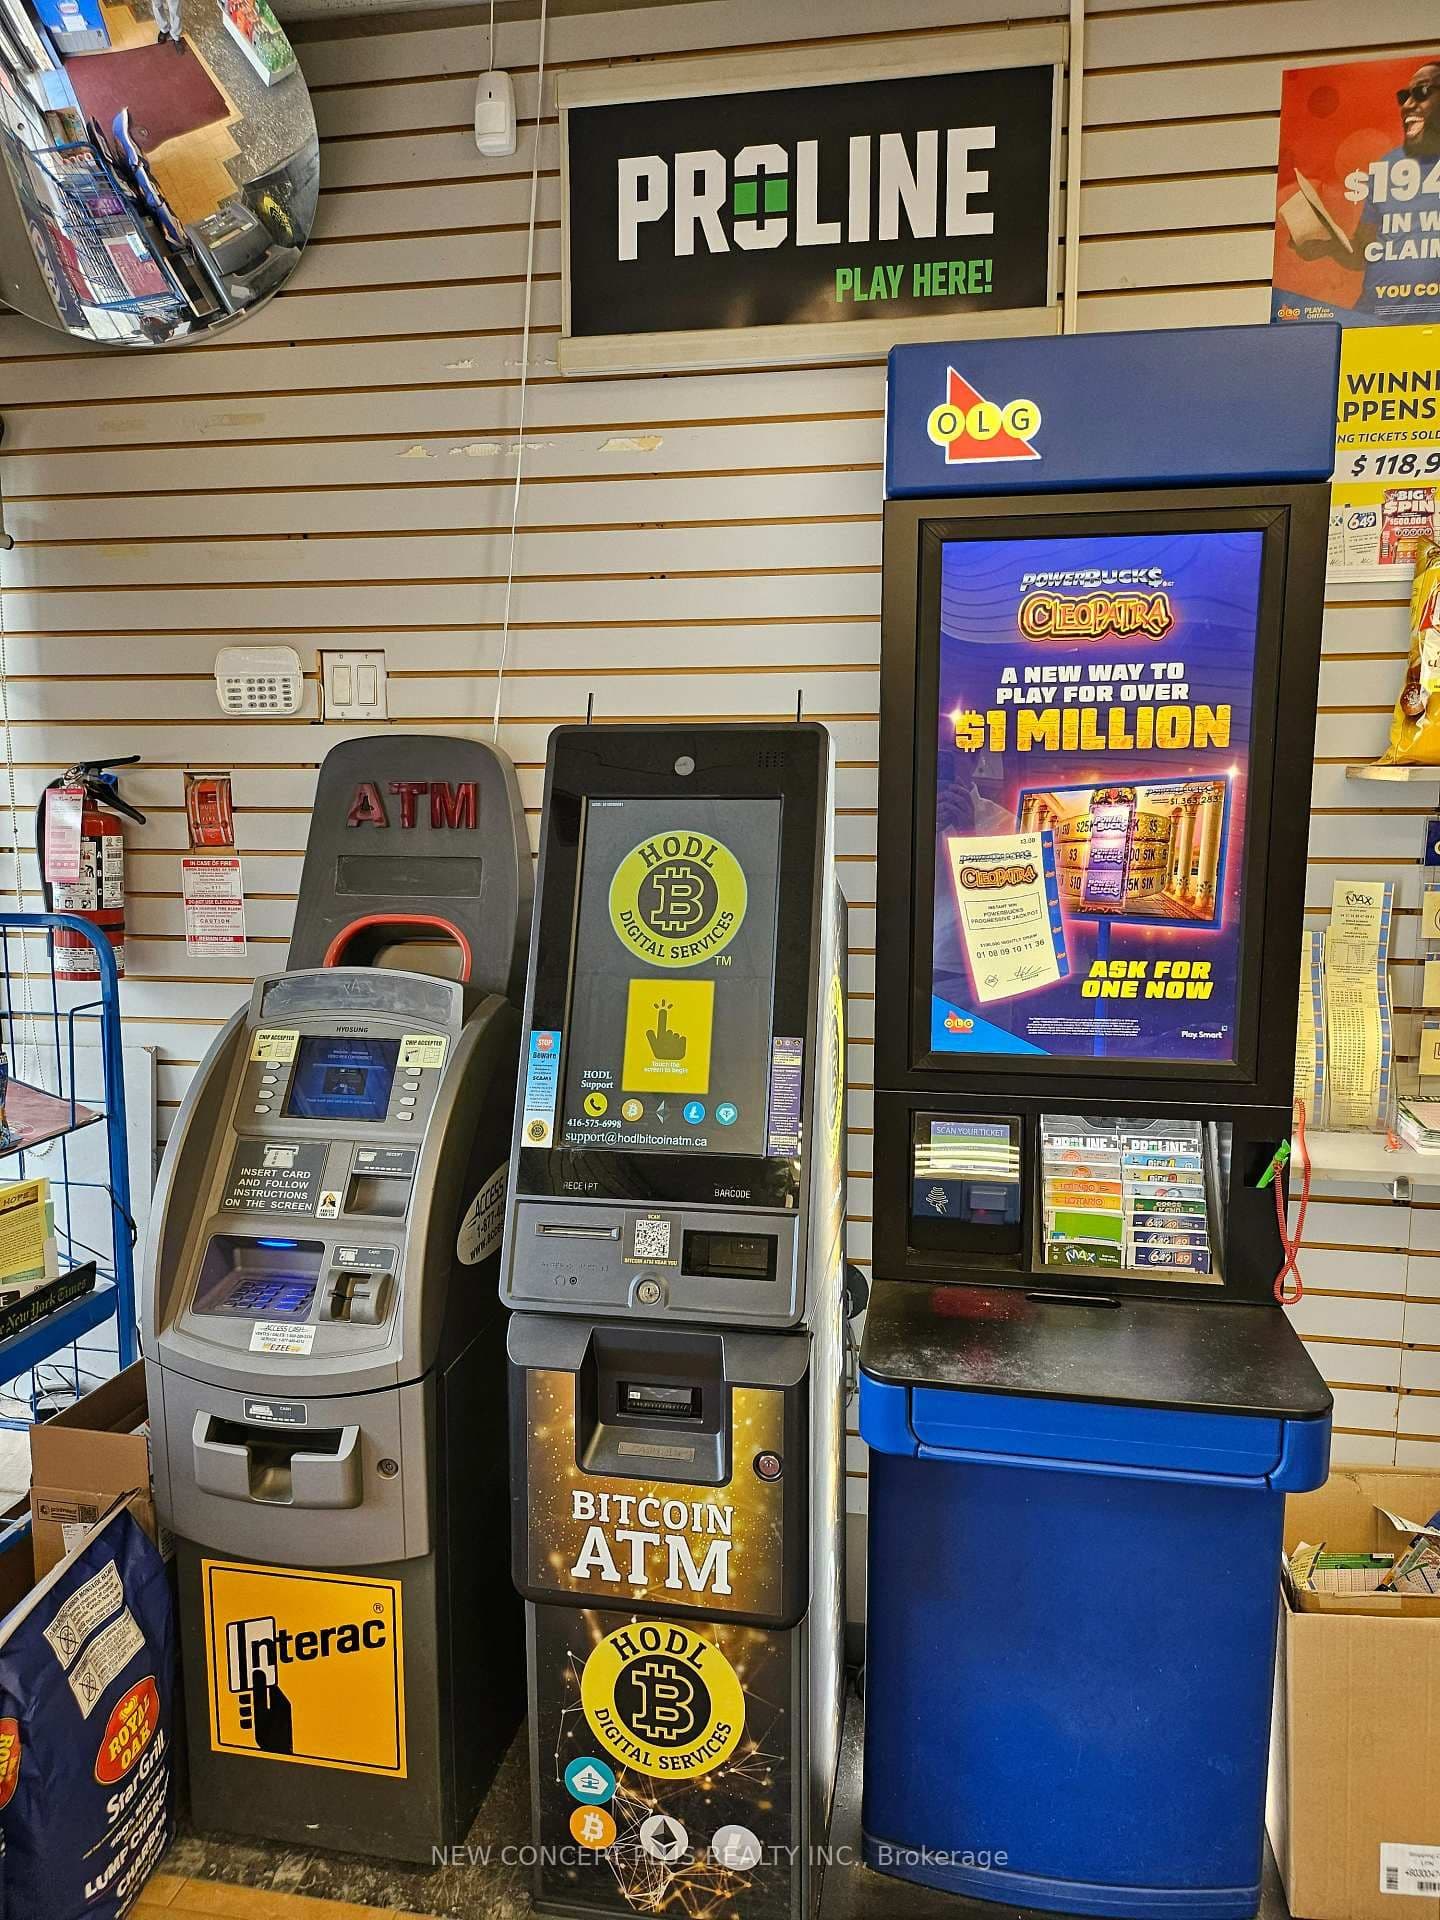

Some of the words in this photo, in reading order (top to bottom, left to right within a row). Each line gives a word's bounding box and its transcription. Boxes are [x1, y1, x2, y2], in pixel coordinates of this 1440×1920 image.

[617, 125, 996, 261] PROLINE
[1381, 211, 1412, 234] IN
[836, 264, 904, 303] PLAY
[912, 258, 994, 297] HERE!
[1375, 285, 1411, 299] YOU
[1414, 283, 1440, 297] CO
[1336, 397, 1437, 424] PPENS
[937, 407, 1030, 436] OLG
[1358, 431, 1408, 443] TICKETS
[1396, 489, 1424, 501] BIG
[1001, 667, 1018, 684] A
[1024, 665, 1082, 684] NEW
[1088, 663, 1146, 683] WAY
[1150, 662, 1185, 680] TO
[996, 687, 1057, 705] PLAY
[1063, 685, 1113, 703] FOR
[1120, 683, 1190, 702] OVER
[955, 709, 1007, 753] $1
[1016, 704, 1233, 752] MILLION
[347, 781, 479, 829] ATM
[638, 836, 719, 869] HODL
[1346, 893, 1373, 905] MAX
[619, 910, 665, 958] DIGITAL
[670, 911, 734, 959] SERVICES
[715, 955, 732, 966] TM
[1088, 961, 1148, 979] ASK
[1153, 961, 1211, 979] FOR
[1081, 980, 1139, 999] ONE
[1144, 980, 1214, 1000] NOW
[538, 1039, 553, 1047] STOP
[580, 1079, 614, 1090] Support
[583, 1070, 612, 1080] HODL
[567, 1118, 622, 1129] 416-575-6998
[936, 1126, 957, 1134] SCAN
[957, 1127, 979, 1136] YOUR
[979, 1128, 1004, 1137] TICKET
[565, 1131, 708, 1147] support@hodlbitcoinatm.ca
[238, 1178, 261, 1187] AND
[265, 1179, 309, 1189] FOLLOW
[240, 1168, 277, 1177] INSERT
[282, 1170, 311, 1179] CARD
[233, 1188, 308, 1200] INSTRUCTIONS
[563, 1181, 599, 1191] RECEIPT
[714, 1188, 751, 1199] BARCODE
[225, 1198, 240, 1207] ON
[245, 1199, 265, 1208] THE
[270, 1200, 312, 1211] SCREEN
[1065, 1248, 1097, 1263] MAX
[30, 1294, 57, 1321] York
[57, 1278, 87, 1300] Times
[264, 1324, 288, 1332] ACCESS
[269, 1344, 290, 1352] EZEE
[571, 1490, 734, 1536] BITCOIN
[570, 1525, 733, 1595] ATM
[236, 1617, 387, 1690] Interac
[609, 1626, 709, 1669] HODL
[108, 1694, 151, 1762] ROYAL
[121, 1726, 152, 1770] OAK
[594, 1707, 652, 1767] DIGITAL
[659, 1721, 732, 1770] SERVICES
[84, 1844, 130, 1900] LUMP
